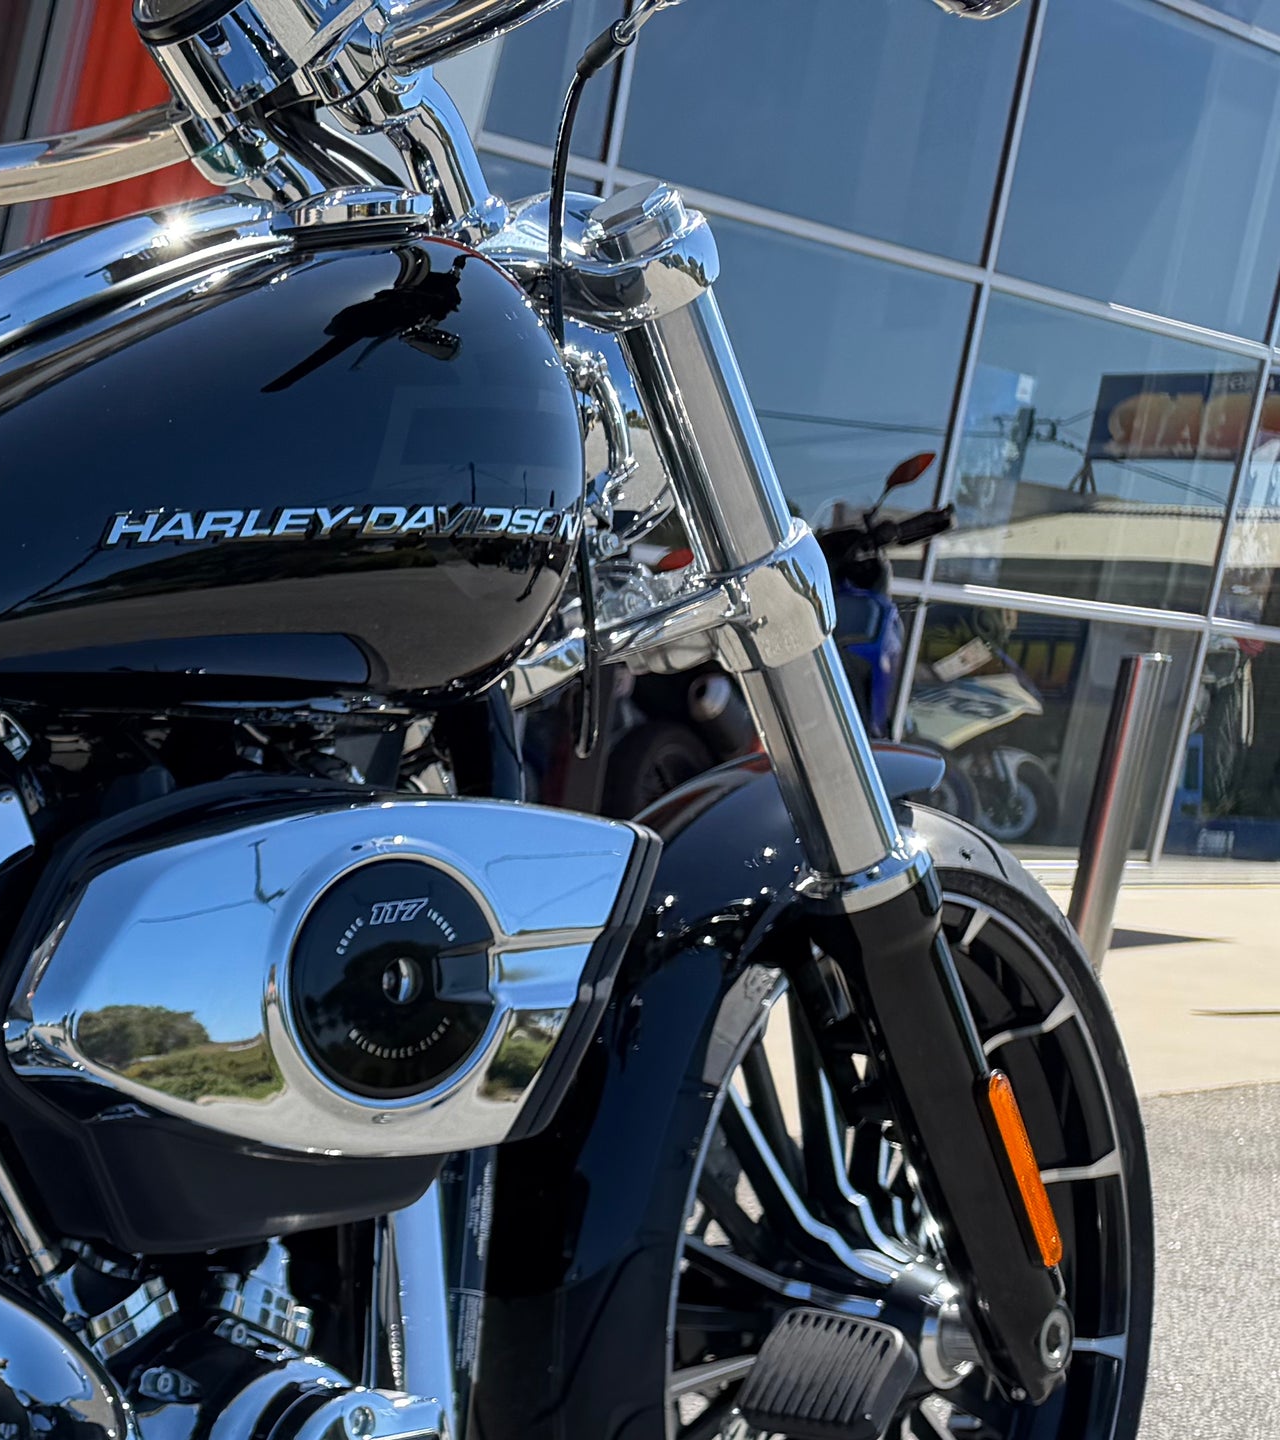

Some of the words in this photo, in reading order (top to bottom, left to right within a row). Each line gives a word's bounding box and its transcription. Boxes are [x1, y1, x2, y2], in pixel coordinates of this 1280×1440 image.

[104, 504, 581, 546] HARLEY-DAVIDSON
[336, 916, 365, 956] CUBIC
[369, 897, 429, 926] 117
[426, 907, 459, 943] INCHES
[348, 1016, 452, 1060] MILWAUKEE-EIGHT
